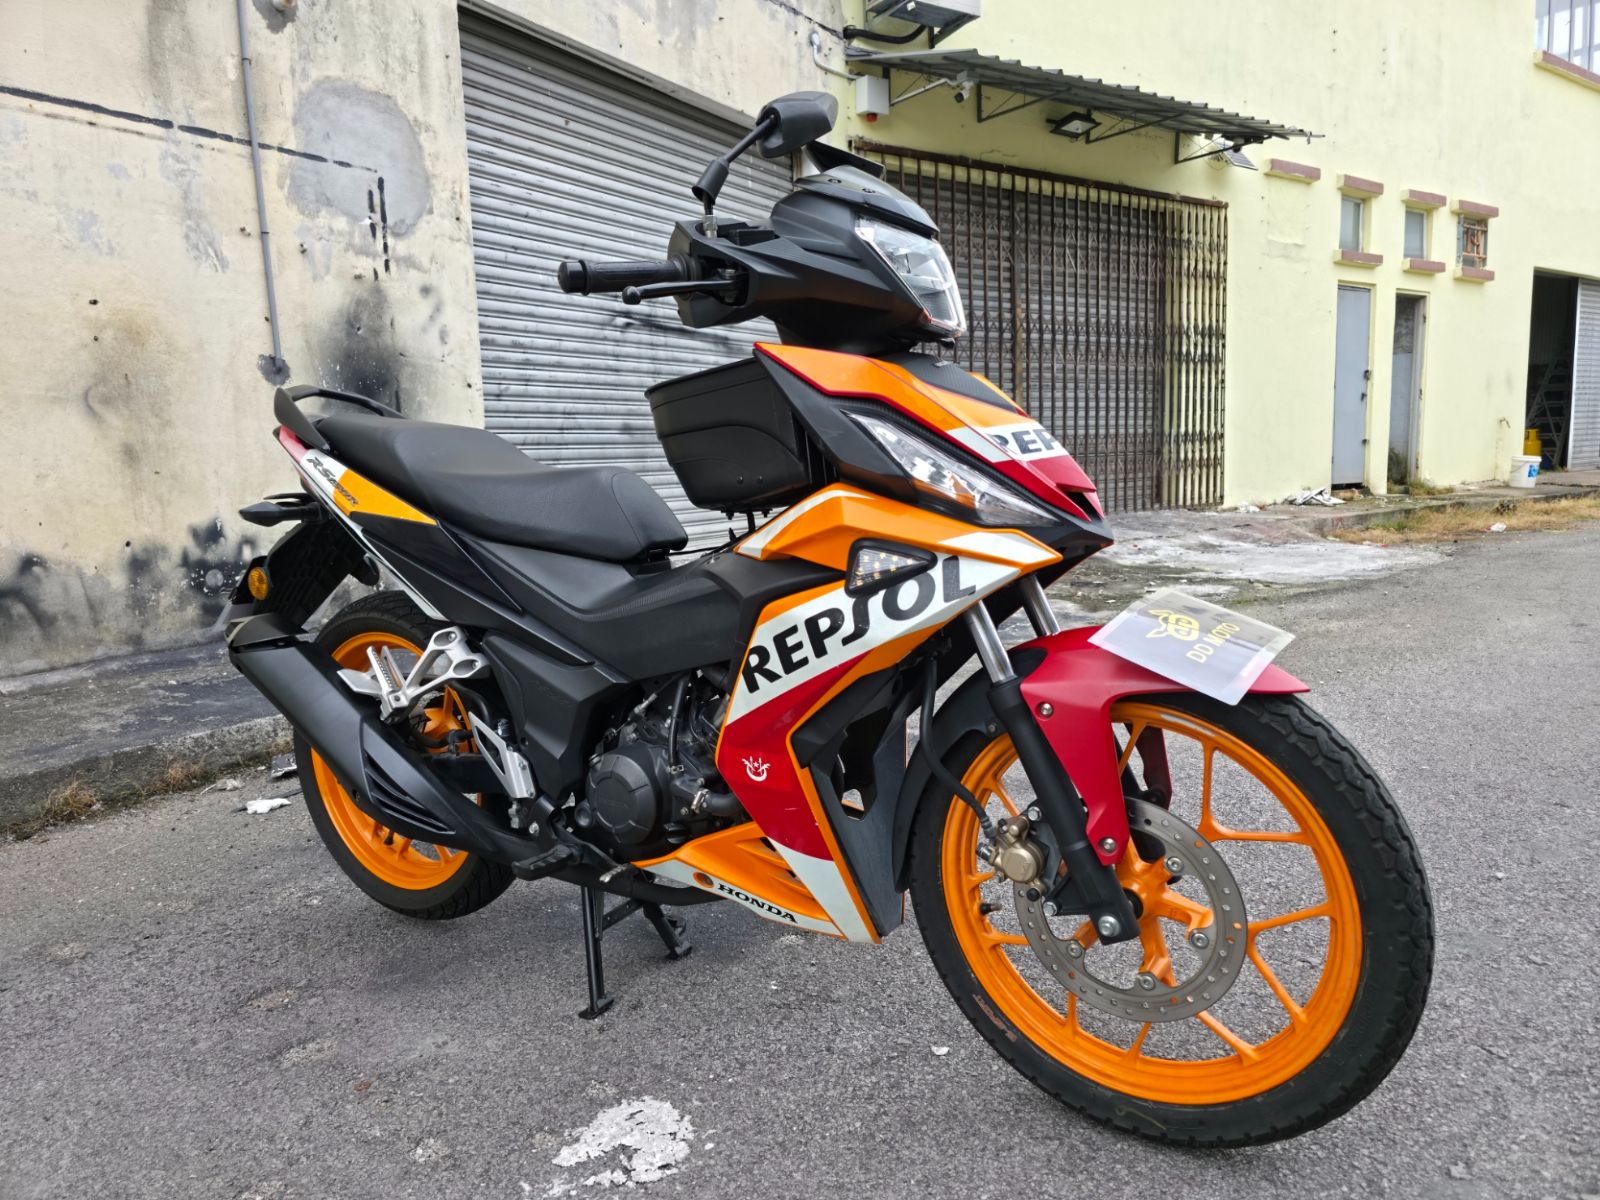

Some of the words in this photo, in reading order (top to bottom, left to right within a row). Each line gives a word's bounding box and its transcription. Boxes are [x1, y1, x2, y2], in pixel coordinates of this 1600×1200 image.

[741, 555, 977, 694] REPSOL
[1185, 643, 1214, 664] DD
[1203, 622, 1240, 647] MOTO
[718, 883, 798, 924] HONDA
